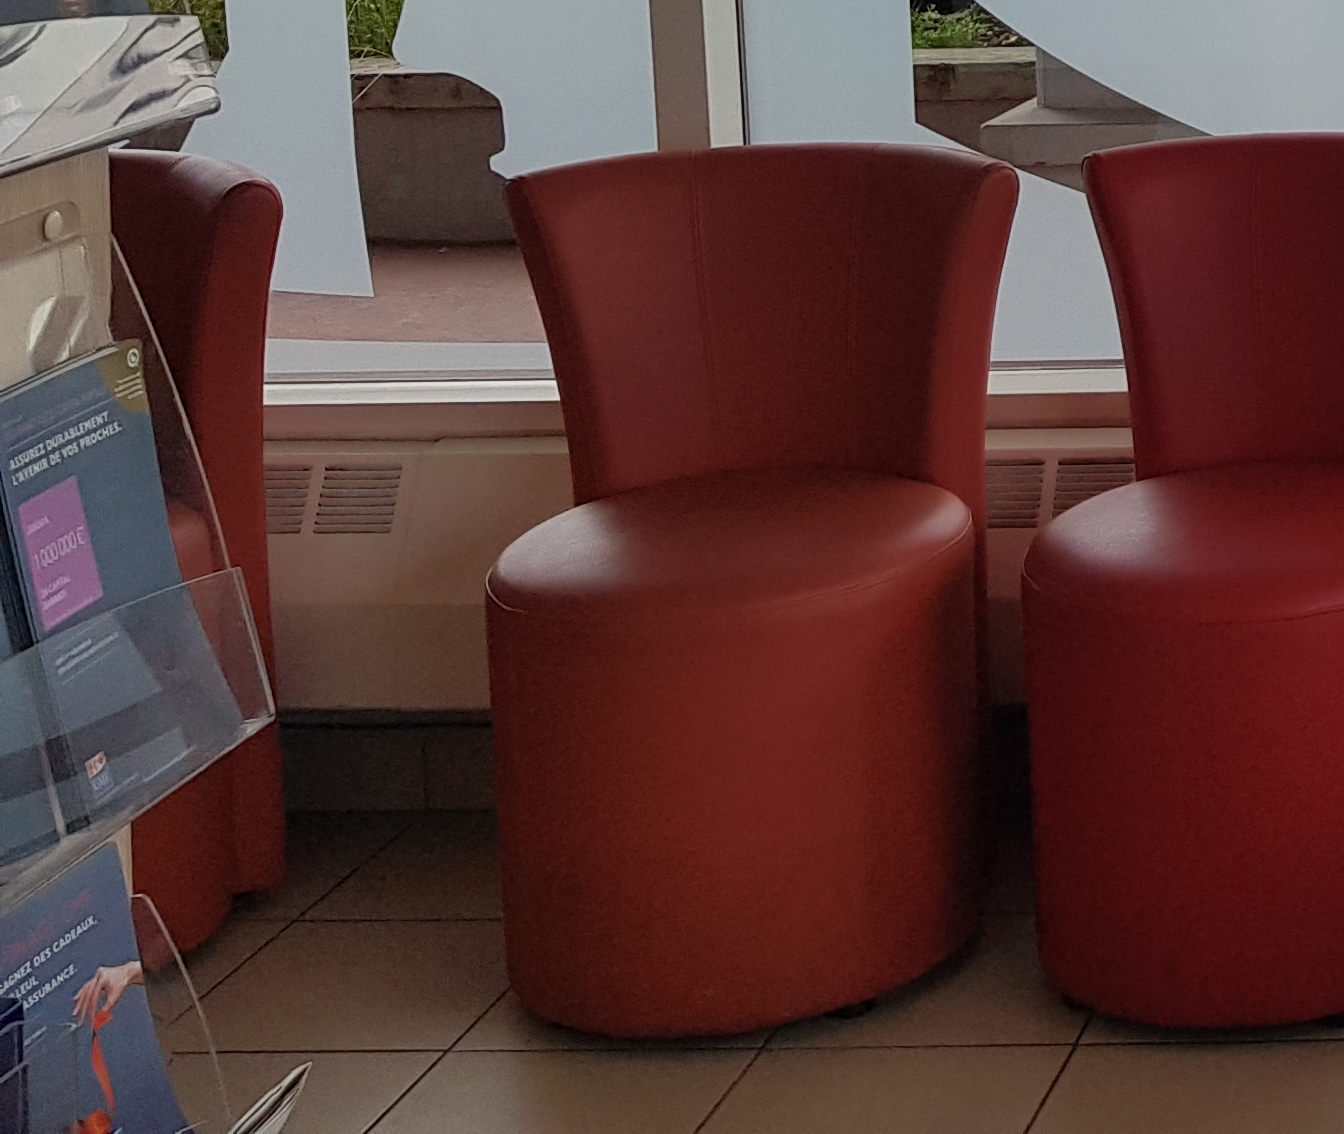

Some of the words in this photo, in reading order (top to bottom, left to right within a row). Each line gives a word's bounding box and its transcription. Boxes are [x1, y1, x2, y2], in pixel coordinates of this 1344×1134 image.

[45, 411, 109, 451] DURABLEMENT
[49, 450, 61, 466] DE
[61, 442, 79, 458] VOS
[32, 947, 52, 967] DES
[52, 915, 98, 953] CADEAUX.
